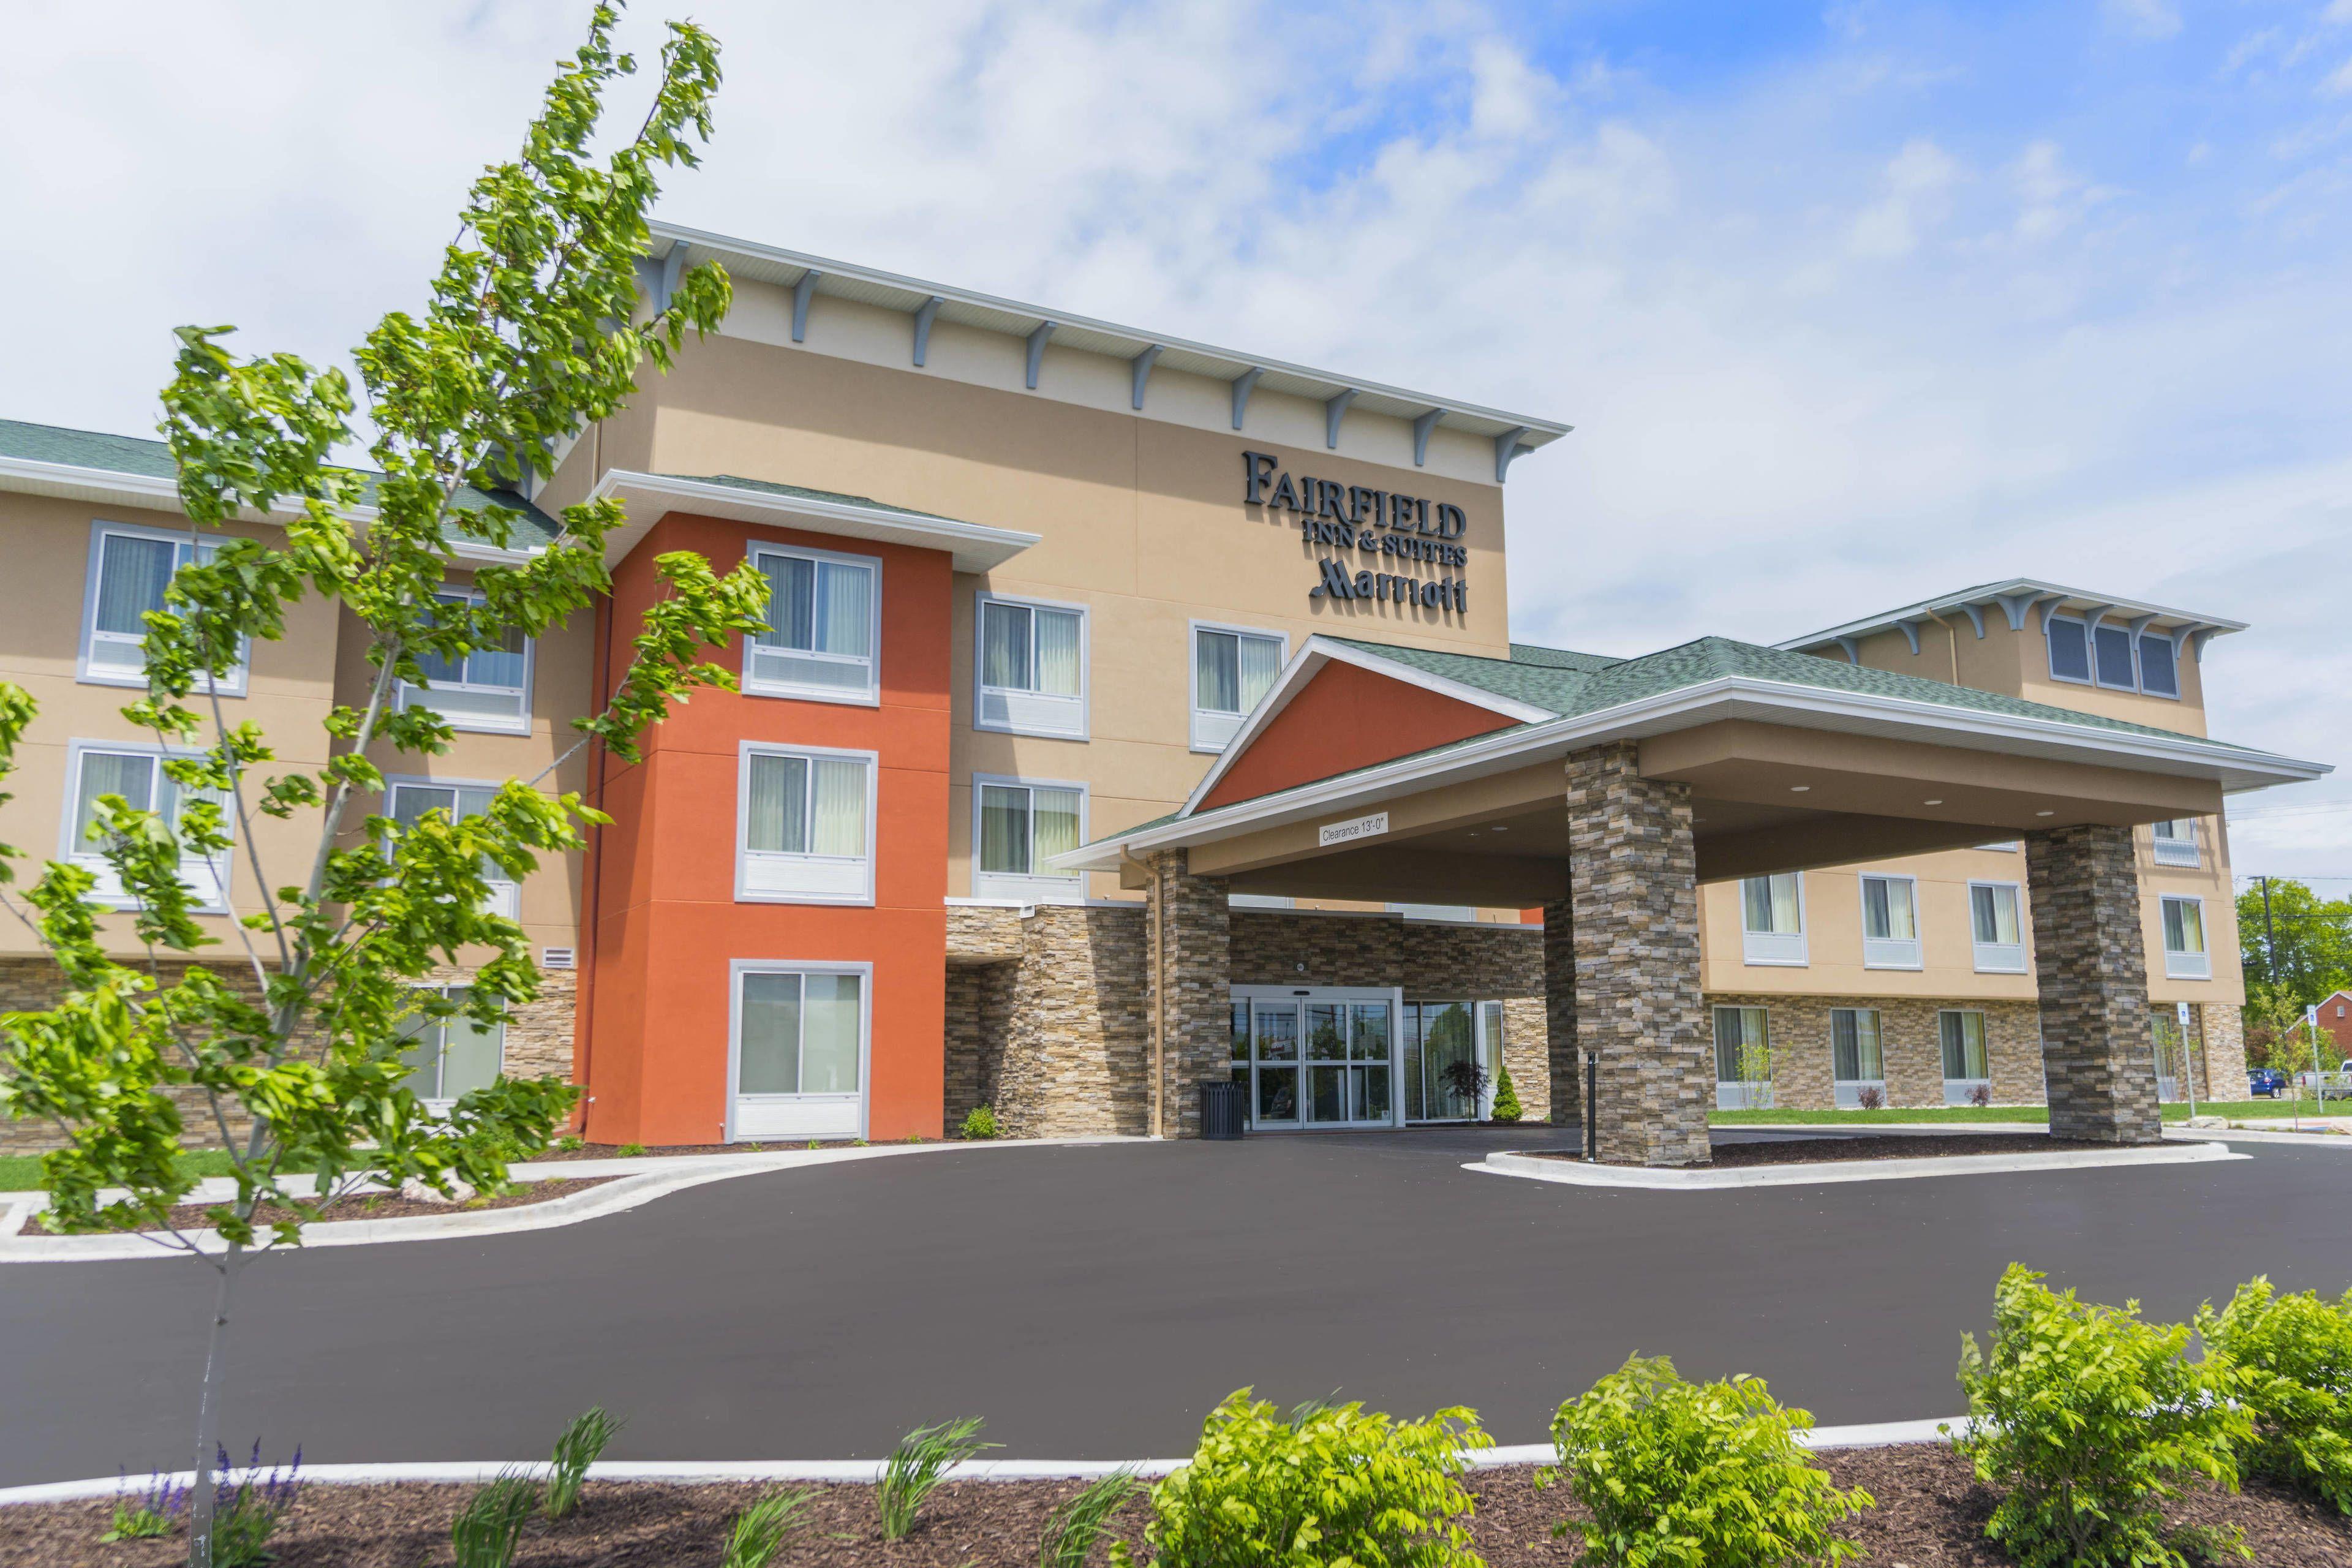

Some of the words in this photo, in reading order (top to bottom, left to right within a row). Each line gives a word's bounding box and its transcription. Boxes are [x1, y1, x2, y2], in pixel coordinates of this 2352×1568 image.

[1242, 451, 1467, 540] FAIRFIELD
[1302, 519, 1356, 548] INN
[1358, 529, 1379, 552] &
[1381, 533, 1468, 567] SUITES
[1309, 557, 1469, 613] Marriott
[1322, 825, 1359, 842] Clearance
[1362, 817, 1384, 833] 13'-0"
